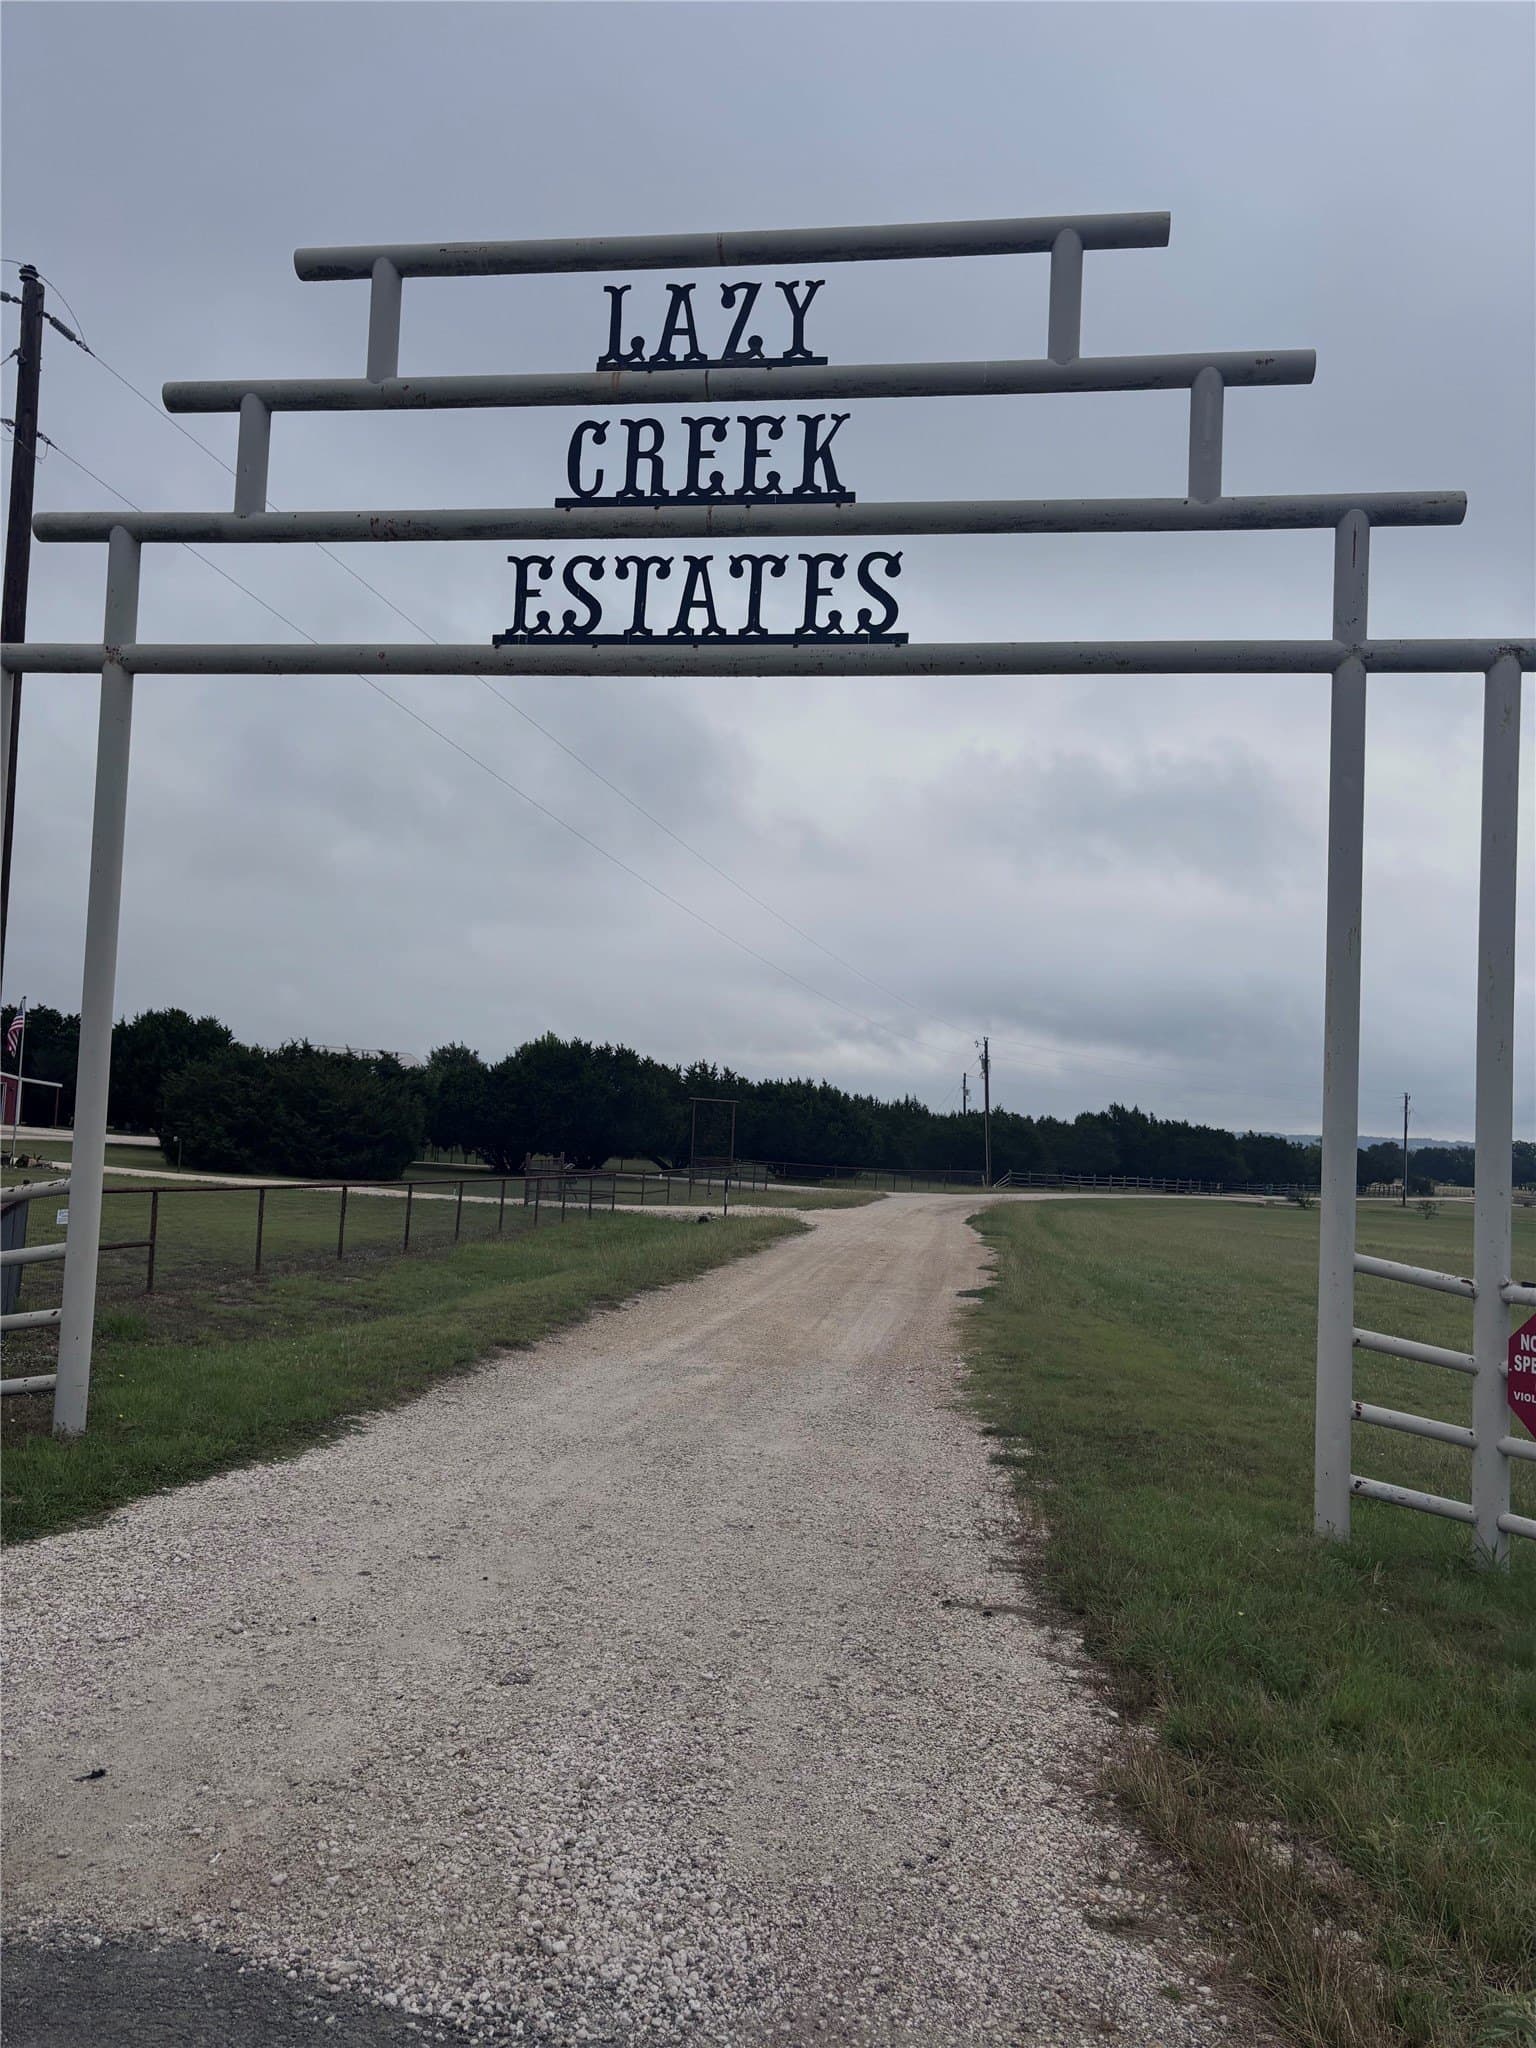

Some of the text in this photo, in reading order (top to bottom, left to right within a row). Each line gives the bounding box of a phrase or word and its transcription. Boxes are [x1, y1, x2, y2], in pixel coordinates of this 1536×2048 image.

[600, 280, 825, 363] LAZY
[566, 413, 850, 499] CREEK
[505, 551, 903, 638] ESTATES
